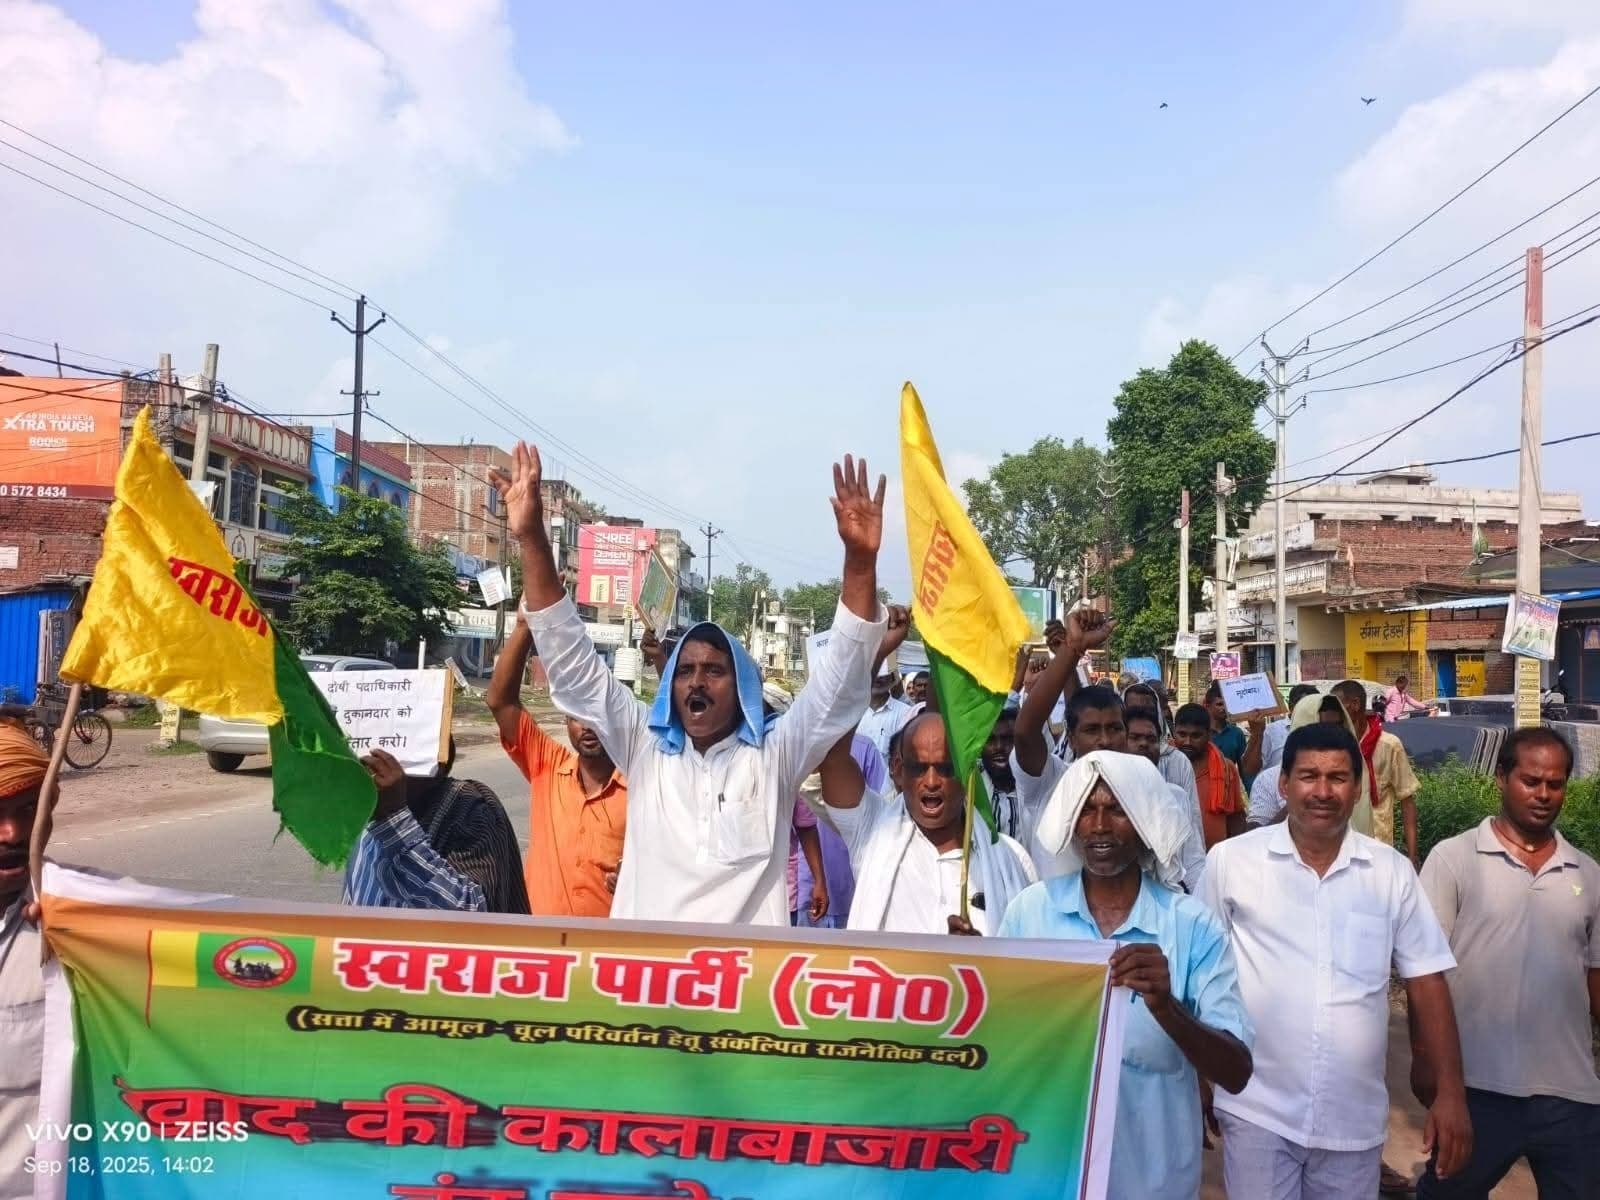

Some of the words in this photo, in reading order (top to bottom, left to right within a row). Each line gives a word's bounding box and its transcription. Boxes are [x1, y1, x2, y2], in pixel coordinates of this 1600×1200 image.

[49, 420, 95, 432] TOUGH
[11, 486, 34, 497] 572
[37, 486, 67, 497] 8434
[594, 533, 632, 544] SHREE
[328, 679, 349, 693] दोषी
[356, 678, 412, 692] पदाधिकारी
[343, 708, 392, 725] दुकानदार
[397, 705, 413, 719] को
[378, 732, 407, 748] करो।
[336, 940, 579, 1000] स्वराज
[592, 948, 752, 1010] पार्टी
[373, 1011, 395, 1030] में
[403, 1016, 485, 1038] आमूल
[514, 1023, 557, 1043] चूल
[566, 1024, 660, 1045] परिवर्तन
[709, 1032, 809, 1056] संकल्पित
[815, 1039, 925, 1061] राजनैतिक
[342, 1083, 478, 1148] की
[502, 1105, 1028, 1173] कालाबाजारी
